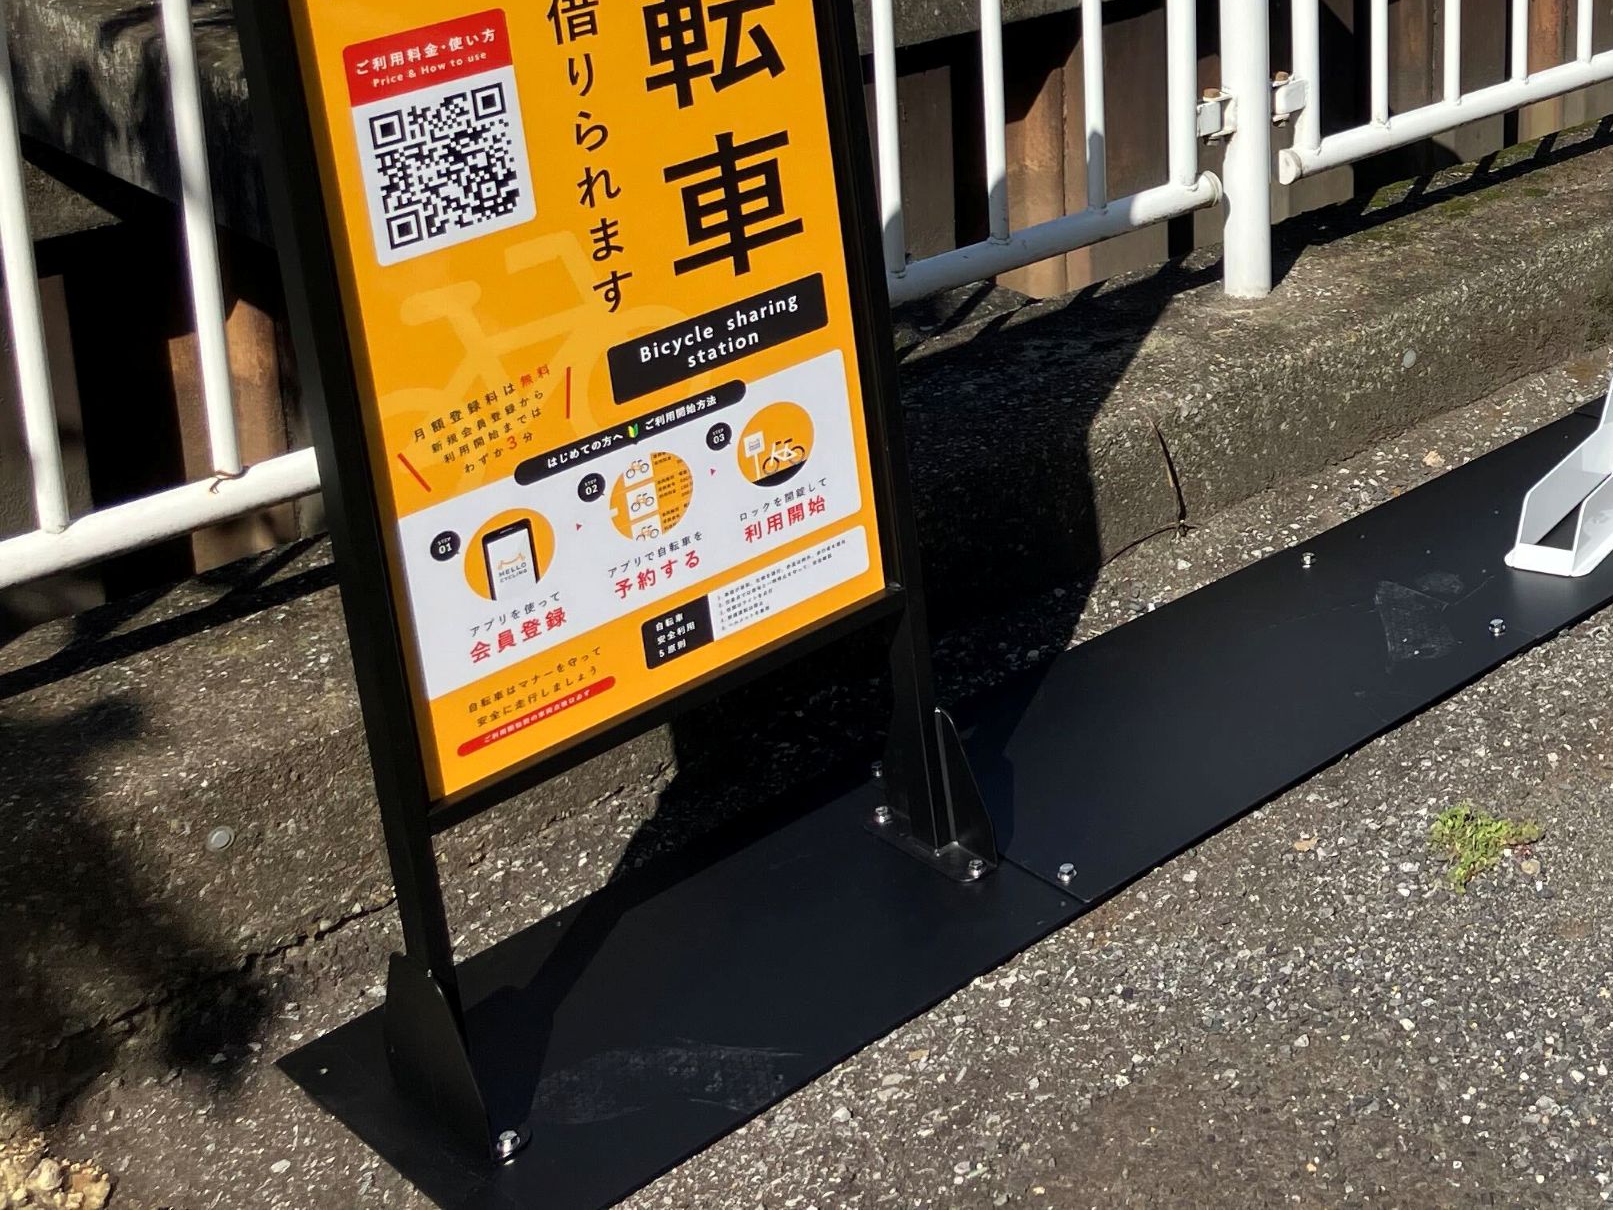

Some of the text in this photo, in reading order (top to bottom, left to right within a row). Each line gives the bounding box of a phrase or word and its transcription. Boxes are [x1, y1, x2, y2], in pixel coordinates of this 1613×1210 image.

[355, 27, 496, 75] ご利用料金・使い方
[373, 51, 487, 88] Price & How to use
[639, 294, 799, 363] Bicycle sharing
[687, 331, 760, 368] station
[547, 395, 717, 468] はじめての方へ ご利用開始方法
[713, 433, 725, 444] 03
[585, 484, 598, 495] 02
[744, 495, 826, 543] 利用開始
[438, 543, 453, 554] 01
[498, 562, 527, 577] HELLO
[608, 531, 703, 578] アプリで自転車を
[614, 550, 700, 600] 予約する
[470, 591, 560, 637] アプリを使って
[470, 607, 567, 663] 会員登録
[655, 612, 684, 632] 自転車
[656, 621, 696, 645] 安全利用
[468, 646, 601, 713] 自転車はマナーを守って
[477, 665, 597, 728] 安全に走行しましょう
